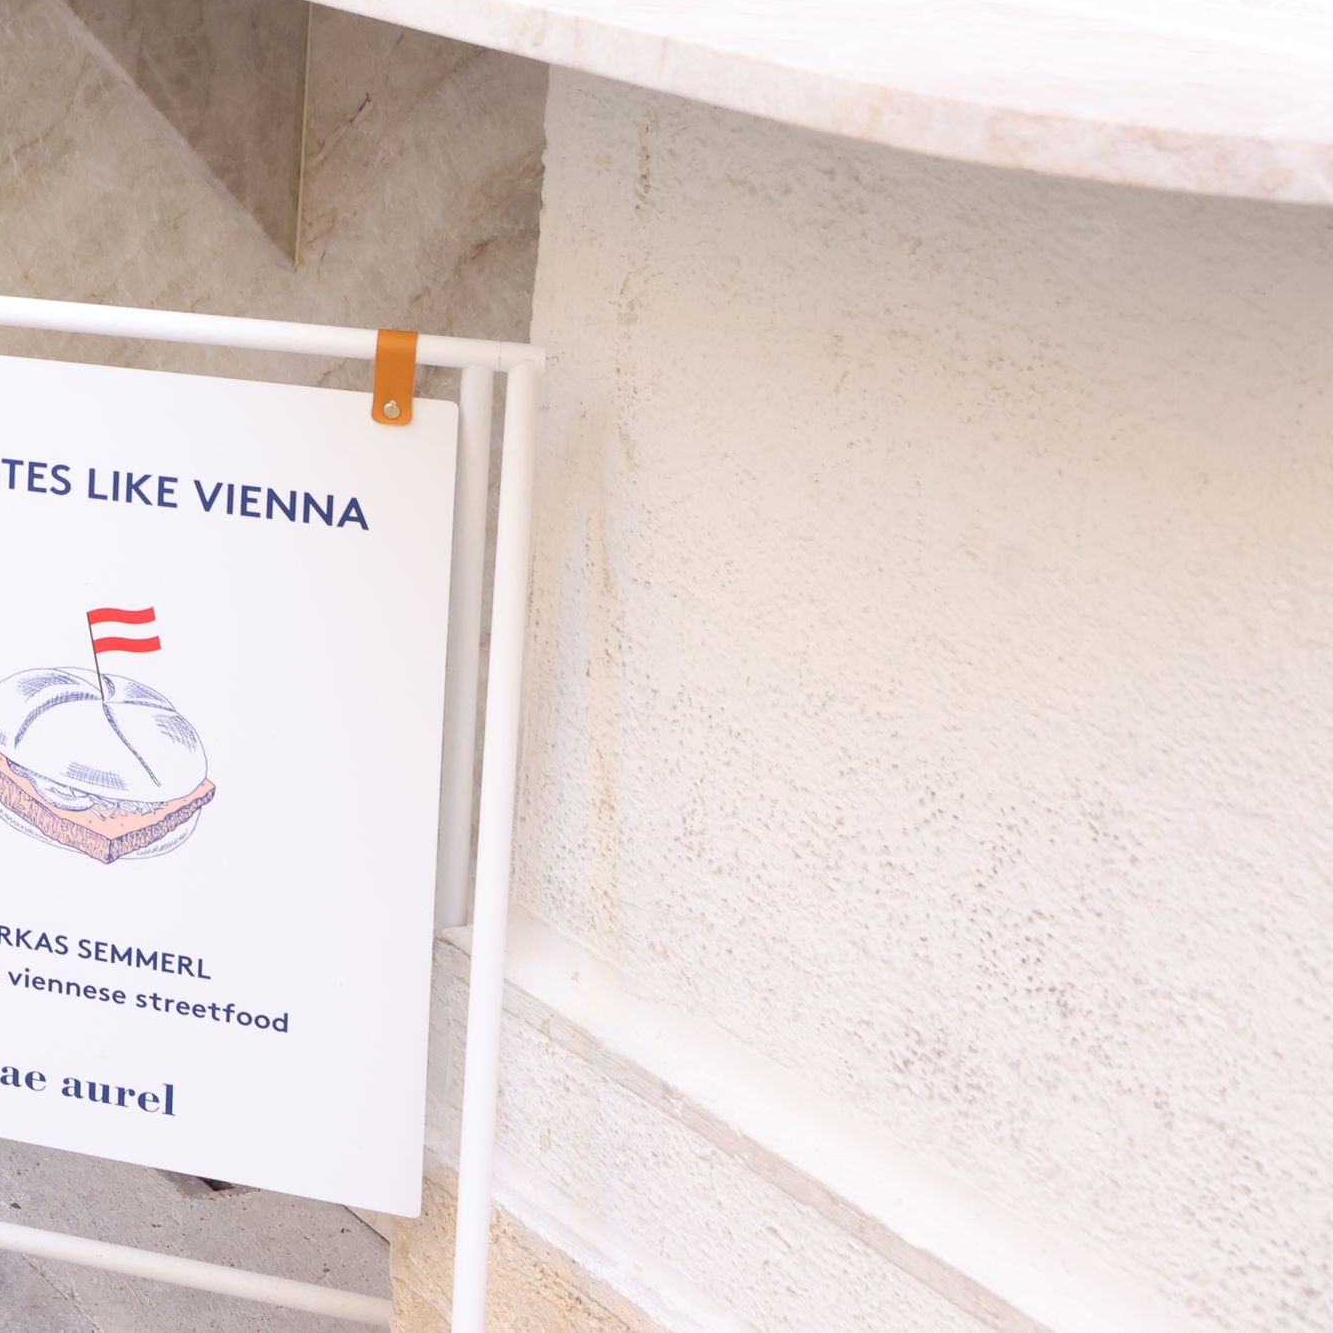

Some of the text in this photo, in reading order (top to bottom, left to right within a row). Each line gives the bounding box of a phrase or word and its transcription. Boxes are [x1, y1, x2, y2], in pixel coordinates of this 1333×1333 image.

[88, 467, 178, 509] LIKE
[193, 479, 370, 531] VIENNA
[77, 939, 212, 980] SEMMERL
[8, 967, 126, 1004] viennese
[135, 992, 289, 1034] streetfood
[61, 1076, 176, 1117] aurel
